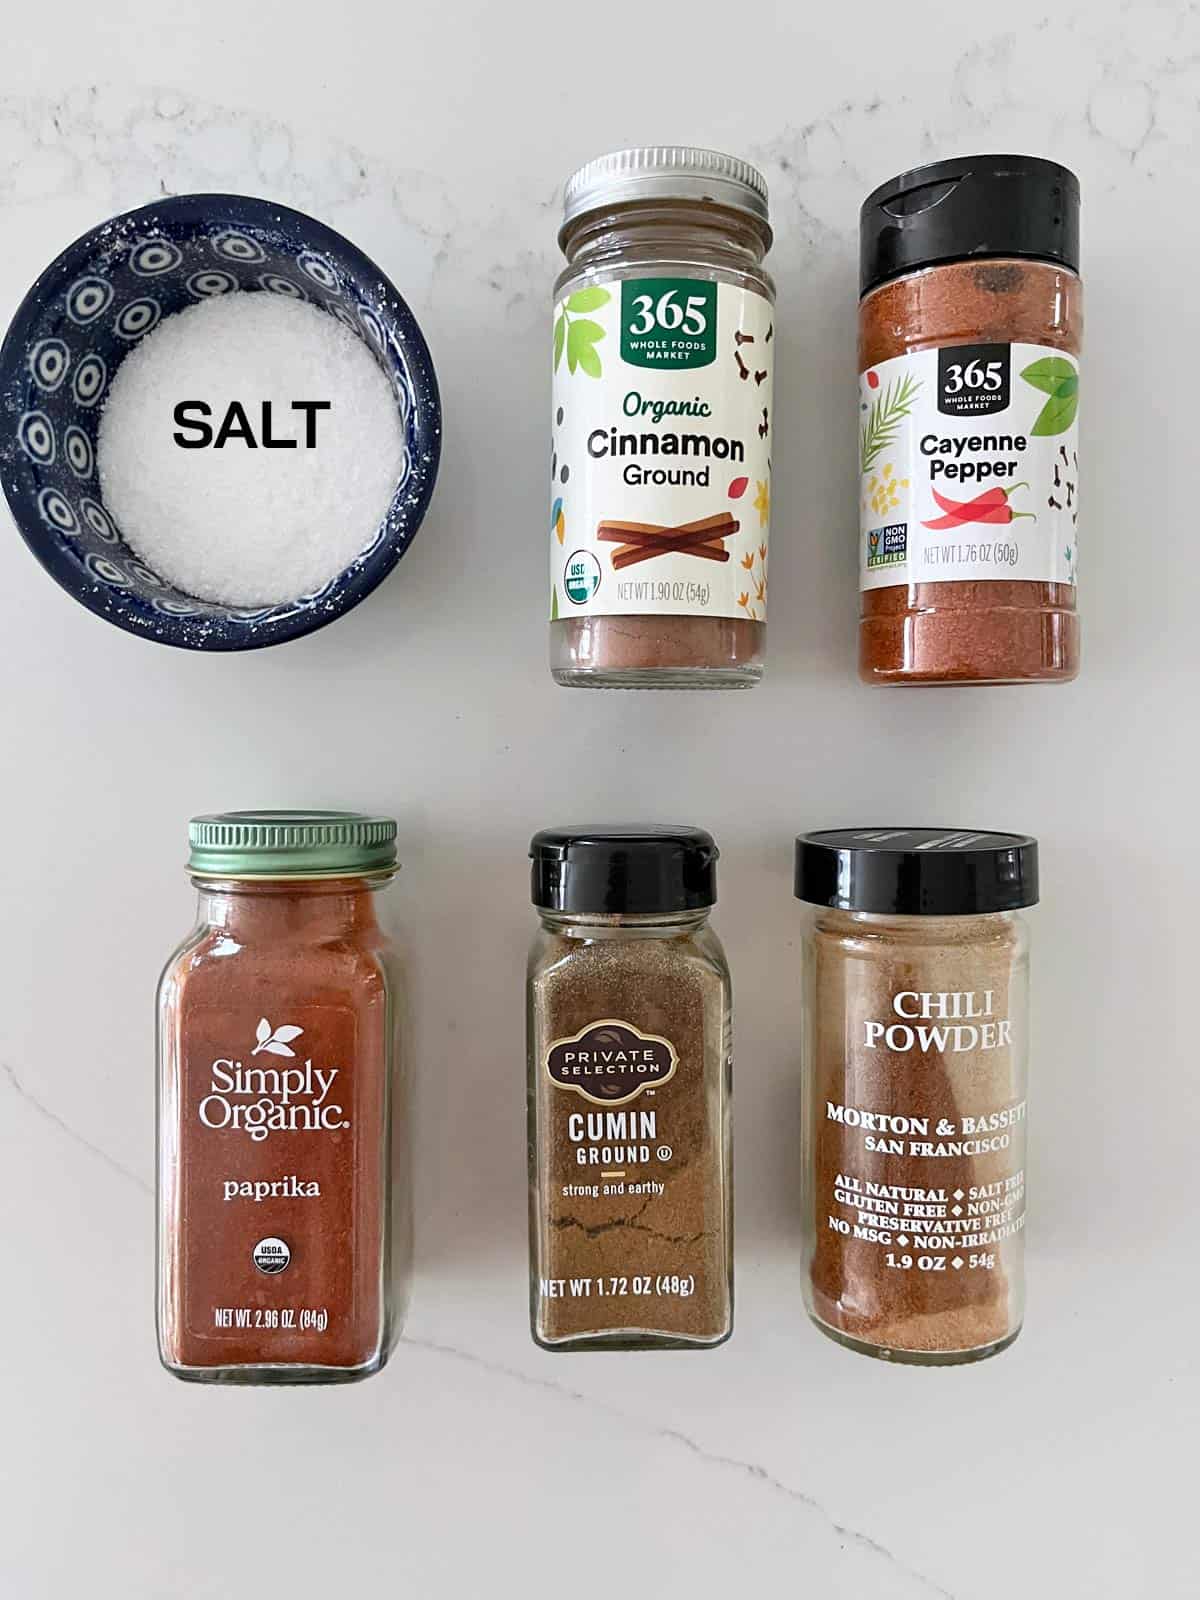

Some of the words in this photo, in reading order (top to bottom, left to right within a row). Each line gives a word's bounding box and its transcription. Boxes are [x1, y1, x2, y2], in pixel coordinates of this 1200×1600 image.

[629, 290, 707, 335] 365
[630, 340, 667, 350] WHOLE
[671, 341, 706, 351] FOODS
[646, 351, 690, 360] MARKET
[944, 359, 1002, 394] 365
[623, 391, 712, 424] Organic
[944, 395, 972, 404] WHOLE
[587, 427, 744, 462] Cinnamon
[920, 434, 1027, 457] Cayenne
[623, 464, 710, 487] Ground
[930, 460, 1018, 482] Pepper
[885, 525, 905, 537] NON
[885, 534, 906, 545] GMO
[924, 546, 939, 564] NET
[941, 545, 956, 563] WT
[957, 544, 977, 563] 1.76
[979, 543, 992, 562] OZ
[993, 542, 1019, 566] (50g)
[617, 582, 633, 601] NET
[634, 582, 648, 601] WT
[650, 582, 671, 601] 1.90
[672, 582, 685, 601] OZ
[686, 582, 710, 606] (54g)
[892, 990, 994, 1018] CHILI
[863, 1021, 1013, 1053] POWDER
[564, 1050, 655, 1063] PRIVATE
[211, 1059, 340, 1105] Simply
[560, 1064, 661, 1076] SELECTION
[568, 1111, 657, 1142] CUMIN
[826, 1101, 930, 1136] MORTON
[935, 1119, 956, 1137] &
[576, 1145, 650, 1165] GROUND
[864, 1136, 905, 1156] SAN
[908, 1134, 1010, 1158] FRANCISCO
[224, 1176, 320, 1201] paprika
[562, 1183, 600, 1197] strong
[603, 1182, 625, 1194] and
[628, 1180, 665, 1195] earthy
[835, 1174, 863, 1193] ALL
[865, 1182, 949, 1203] NATURAL
[968, 1182, 1003, 1201] SALT
[834, 1189, 899, 1215] GLUTEN
[903, 1203, 947, 1218] FREE
[828, 1215, 850, 1235] NO
[853, 1225, 892, 1245] MSG
[857, 1211, 981, 1234] PRESERVATIVE
[984, 1208, 1014, 1229] FREE
[261, 1246, 283, 1254] USDA
[885, 1253, 913, 1269] 1.9
[917, 1255, 946, 1271] OZ
[968, 1253, 995, 1269] 54g
[540, 1279, 566, 1297] NET
[569, 1279, 592, 1297] WT
[596, 1277, 629, 1296] 1.72
[632, 1276, 652, 1295] OZ
[655, 1275, 696, 1297] (48g)
[215, 1308, 233, 1328] NET
[255, 1308, 279, 1328] 2.96
[281, 1308, 297, 1328] OZ.
[299, 1308, 329, 1332] (84g)
